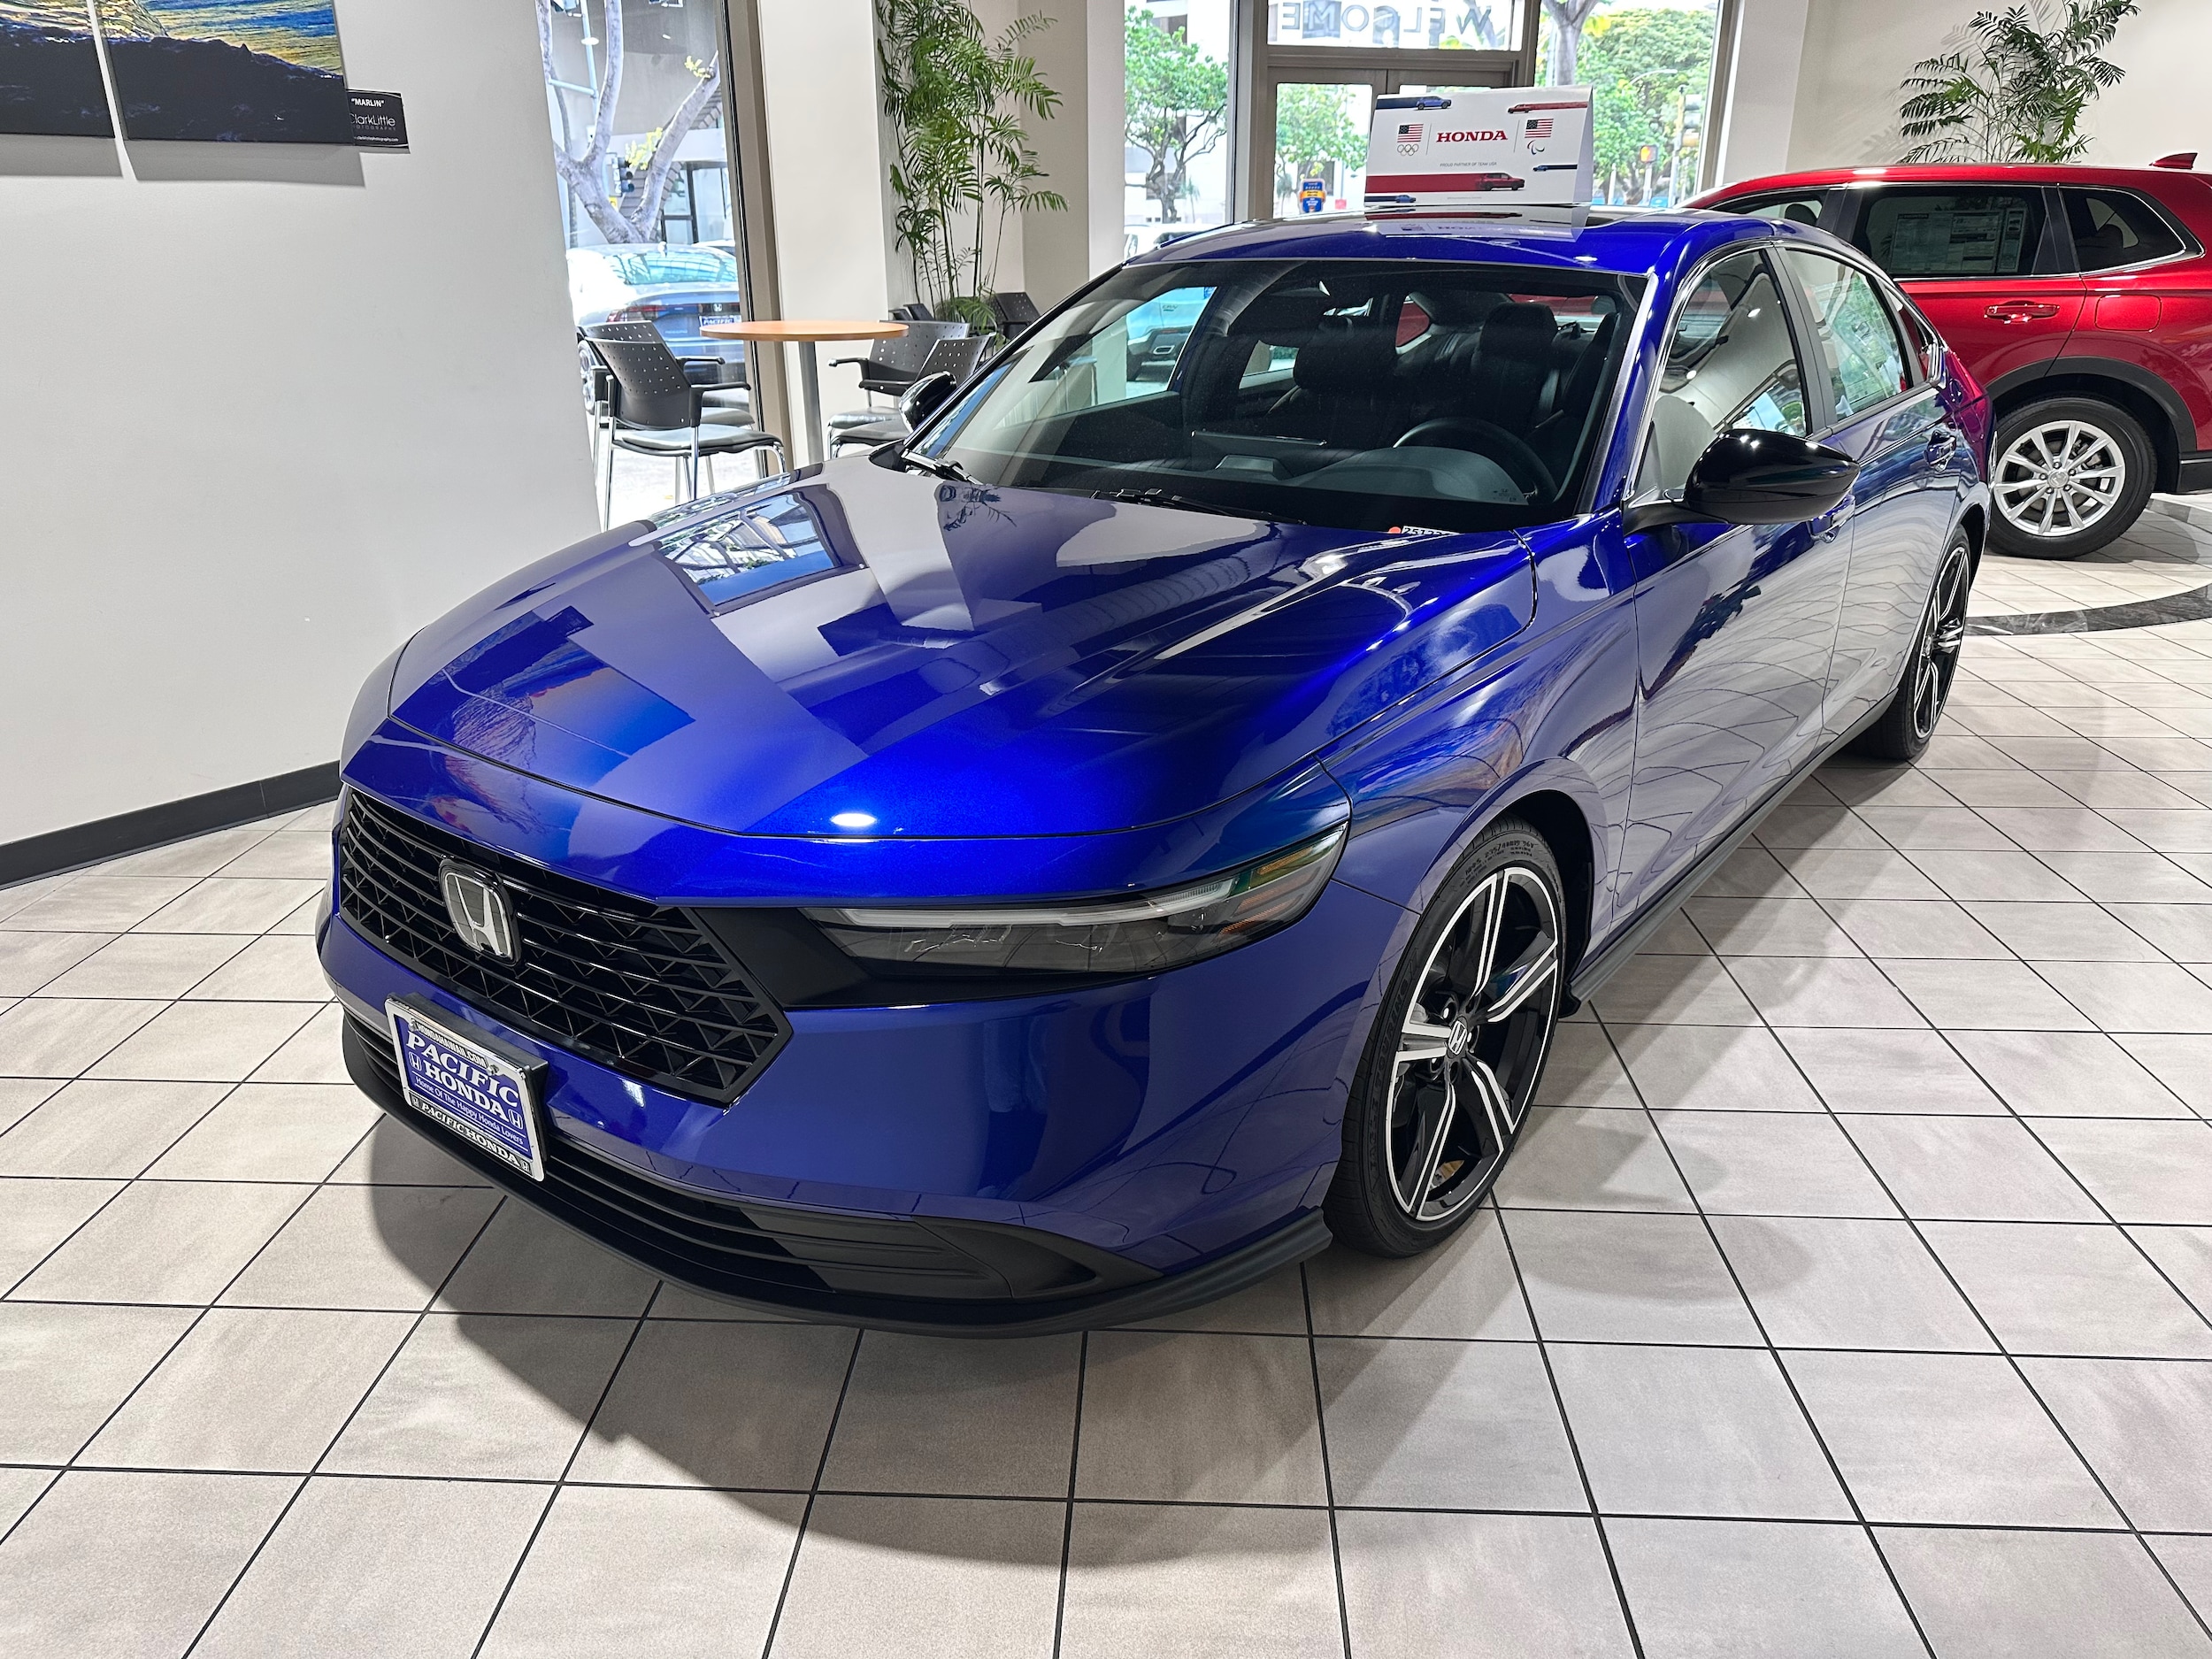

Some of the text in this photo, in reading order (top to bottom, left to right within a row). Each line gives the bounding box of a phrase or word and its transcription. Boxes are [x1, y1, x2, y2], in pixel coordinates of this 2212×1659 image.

[1436, 130, 1508, 142] HONDA
[406, 1030, 519, 1108] PACIFIC
[424, 1060, 511, 1122] HONDA
[416, 1078, 524, 1145] Home Of The Happy Honda Lovers
[421, 1102, 520, 1167] PACIFIC HONDA
